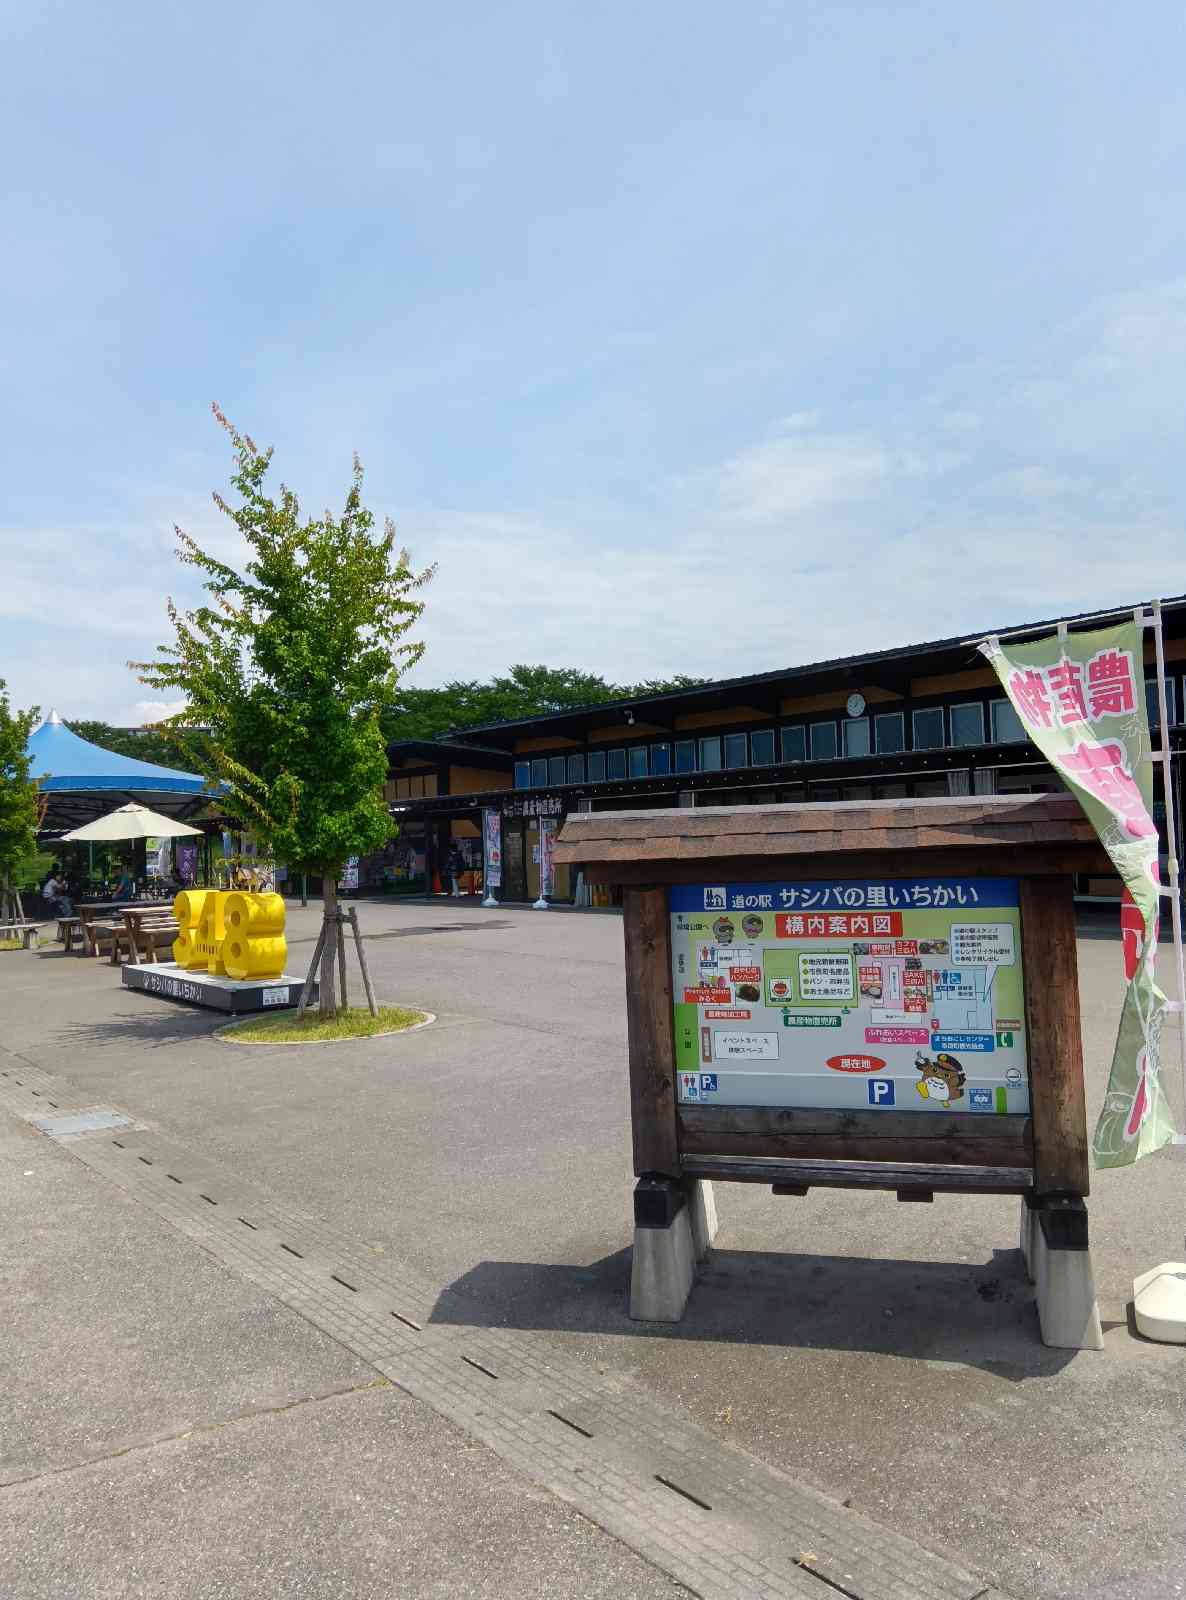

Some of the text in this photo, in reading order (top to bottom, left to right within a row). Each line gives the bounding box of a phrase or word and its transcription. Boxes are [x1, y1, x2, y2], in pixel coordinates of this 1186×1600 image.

[731, 885, 979, 909] 道の駅 サシバの里いちかい
[785, 915, 892, 936] 構内案内図
[873, 1081, 889, 1104] P
